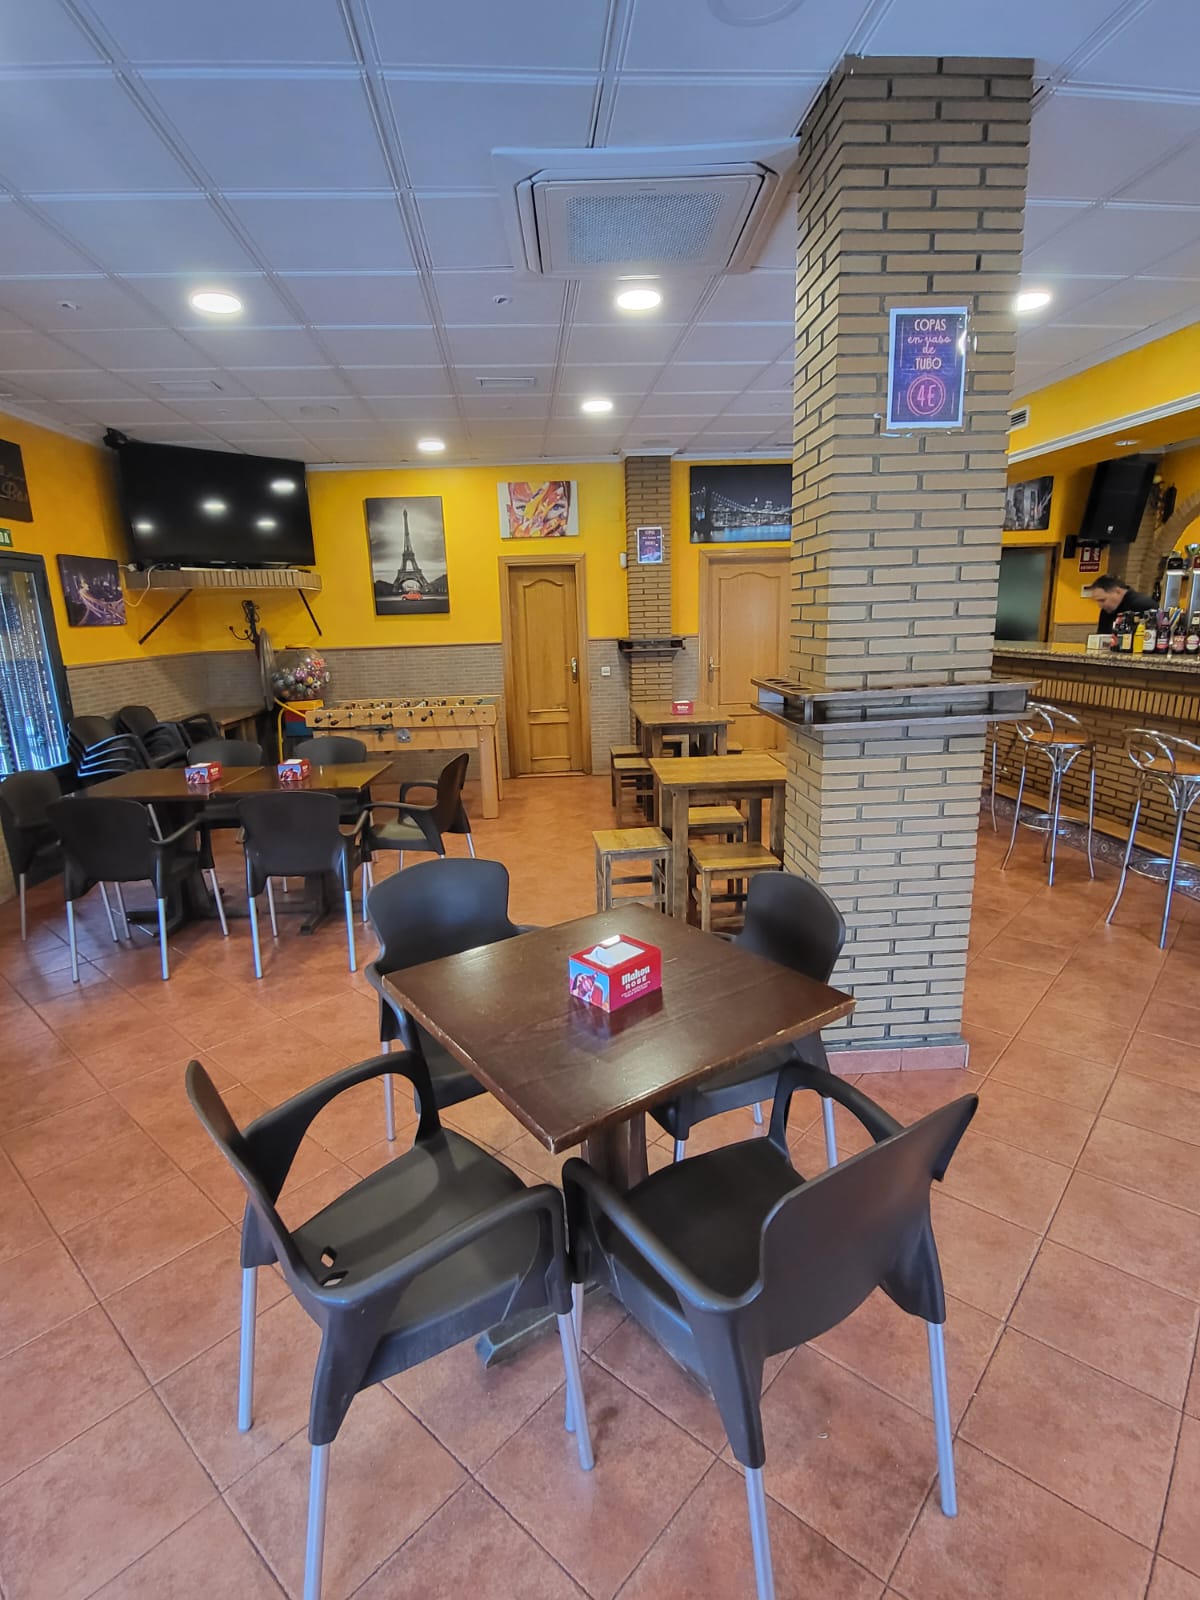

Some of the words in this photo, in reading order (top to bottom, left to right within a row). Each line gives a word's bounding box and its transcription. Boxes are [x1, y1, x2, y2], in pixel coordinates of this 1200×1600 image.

[914, 318, 947, 332] COPAS
[907, 335, 923, 344] en
[924, 335, 952, 345] vaso
[922, 343, 936, 354] de
[915, 357, 942, 370] TUBO
